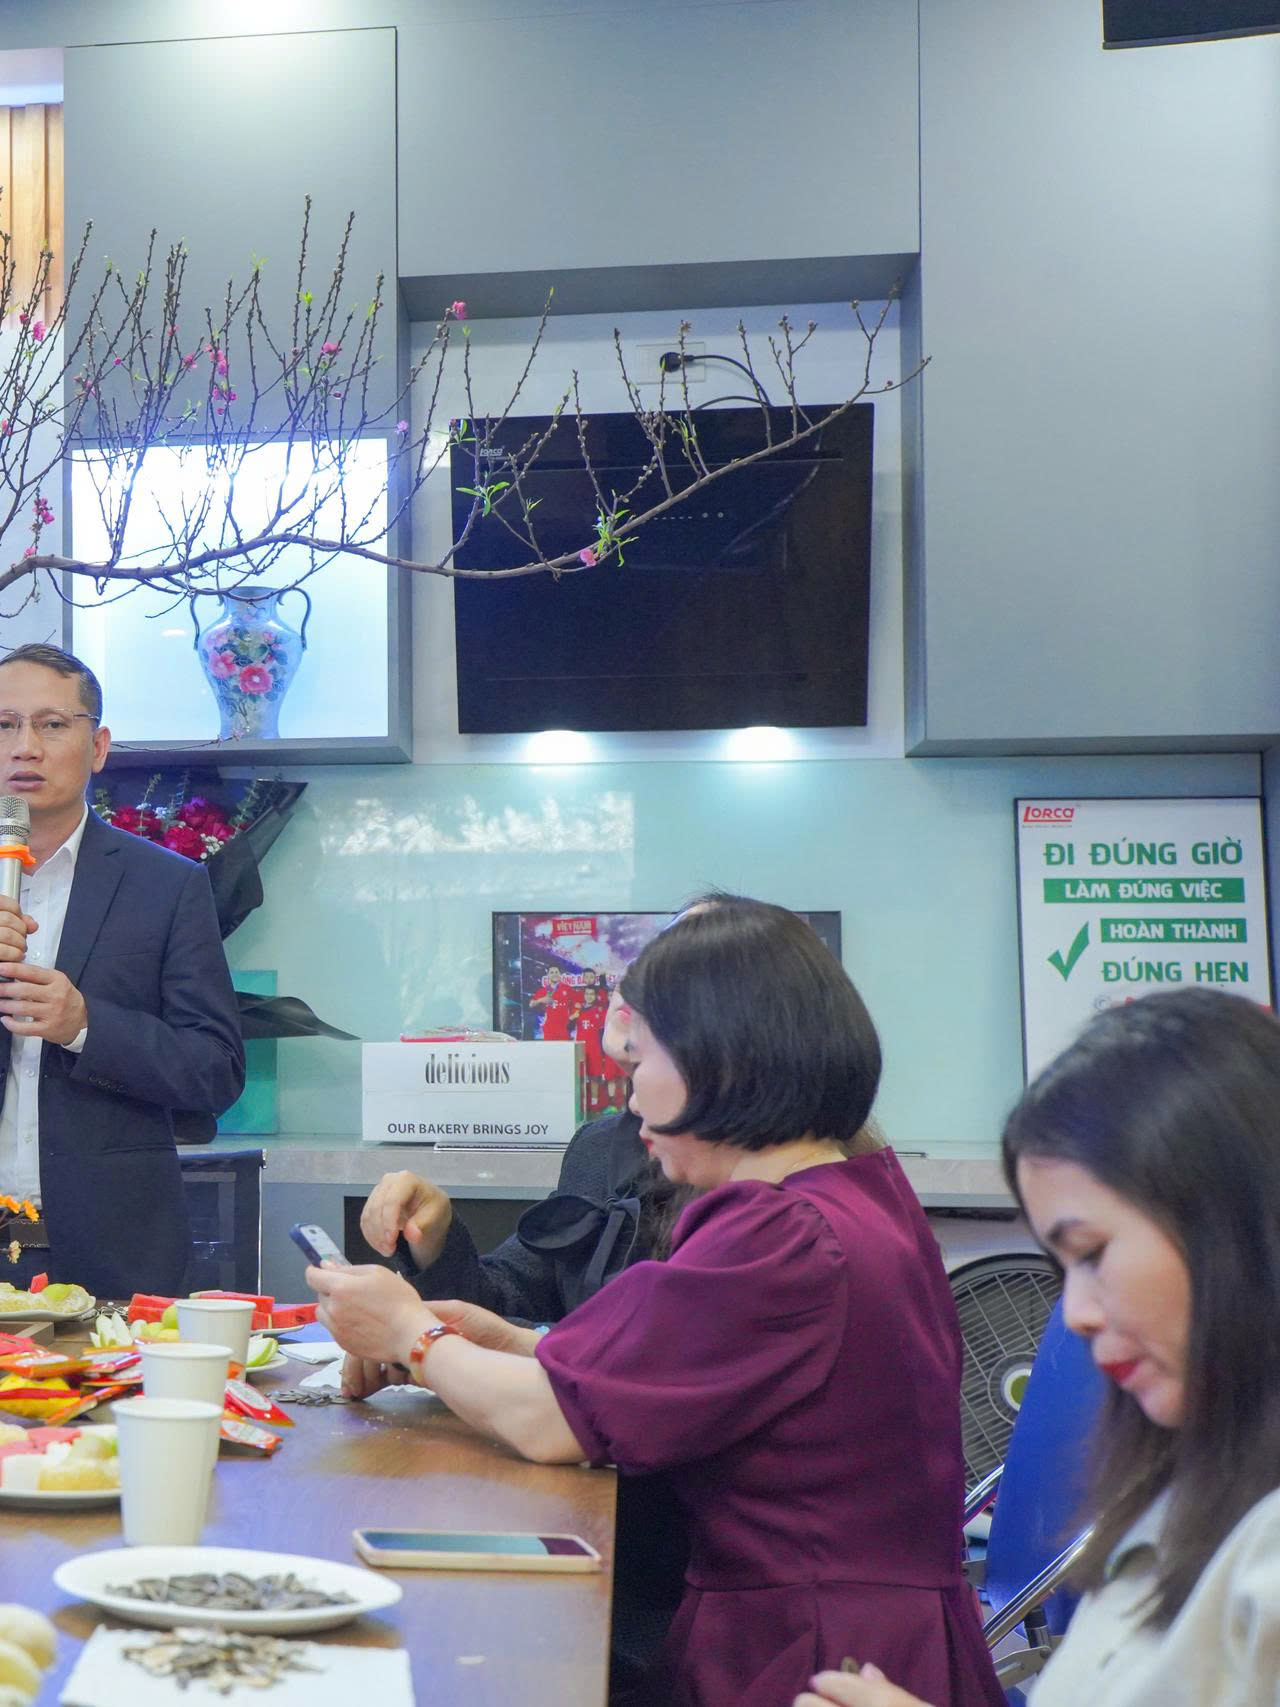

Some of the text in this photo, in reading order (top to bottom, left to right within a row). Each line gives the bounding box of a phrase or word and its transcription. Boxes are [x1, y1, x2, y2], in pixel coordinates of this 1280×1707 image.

[1043, 836, 1242, 865] ĐI ĐÚNG GIỜ
[1065, 880, 1223, 901] LÀM ĐÚNG VIỆC
[1110, 921, 1238, 939] HOÀN THÀNH
[1101, 956, 1249, 987] ĐÚNG HẸN
[425, 1053, 510, 1084] delicious
[387, 1123, 549, 1135] OUR BAKERY BRINGS JOY
